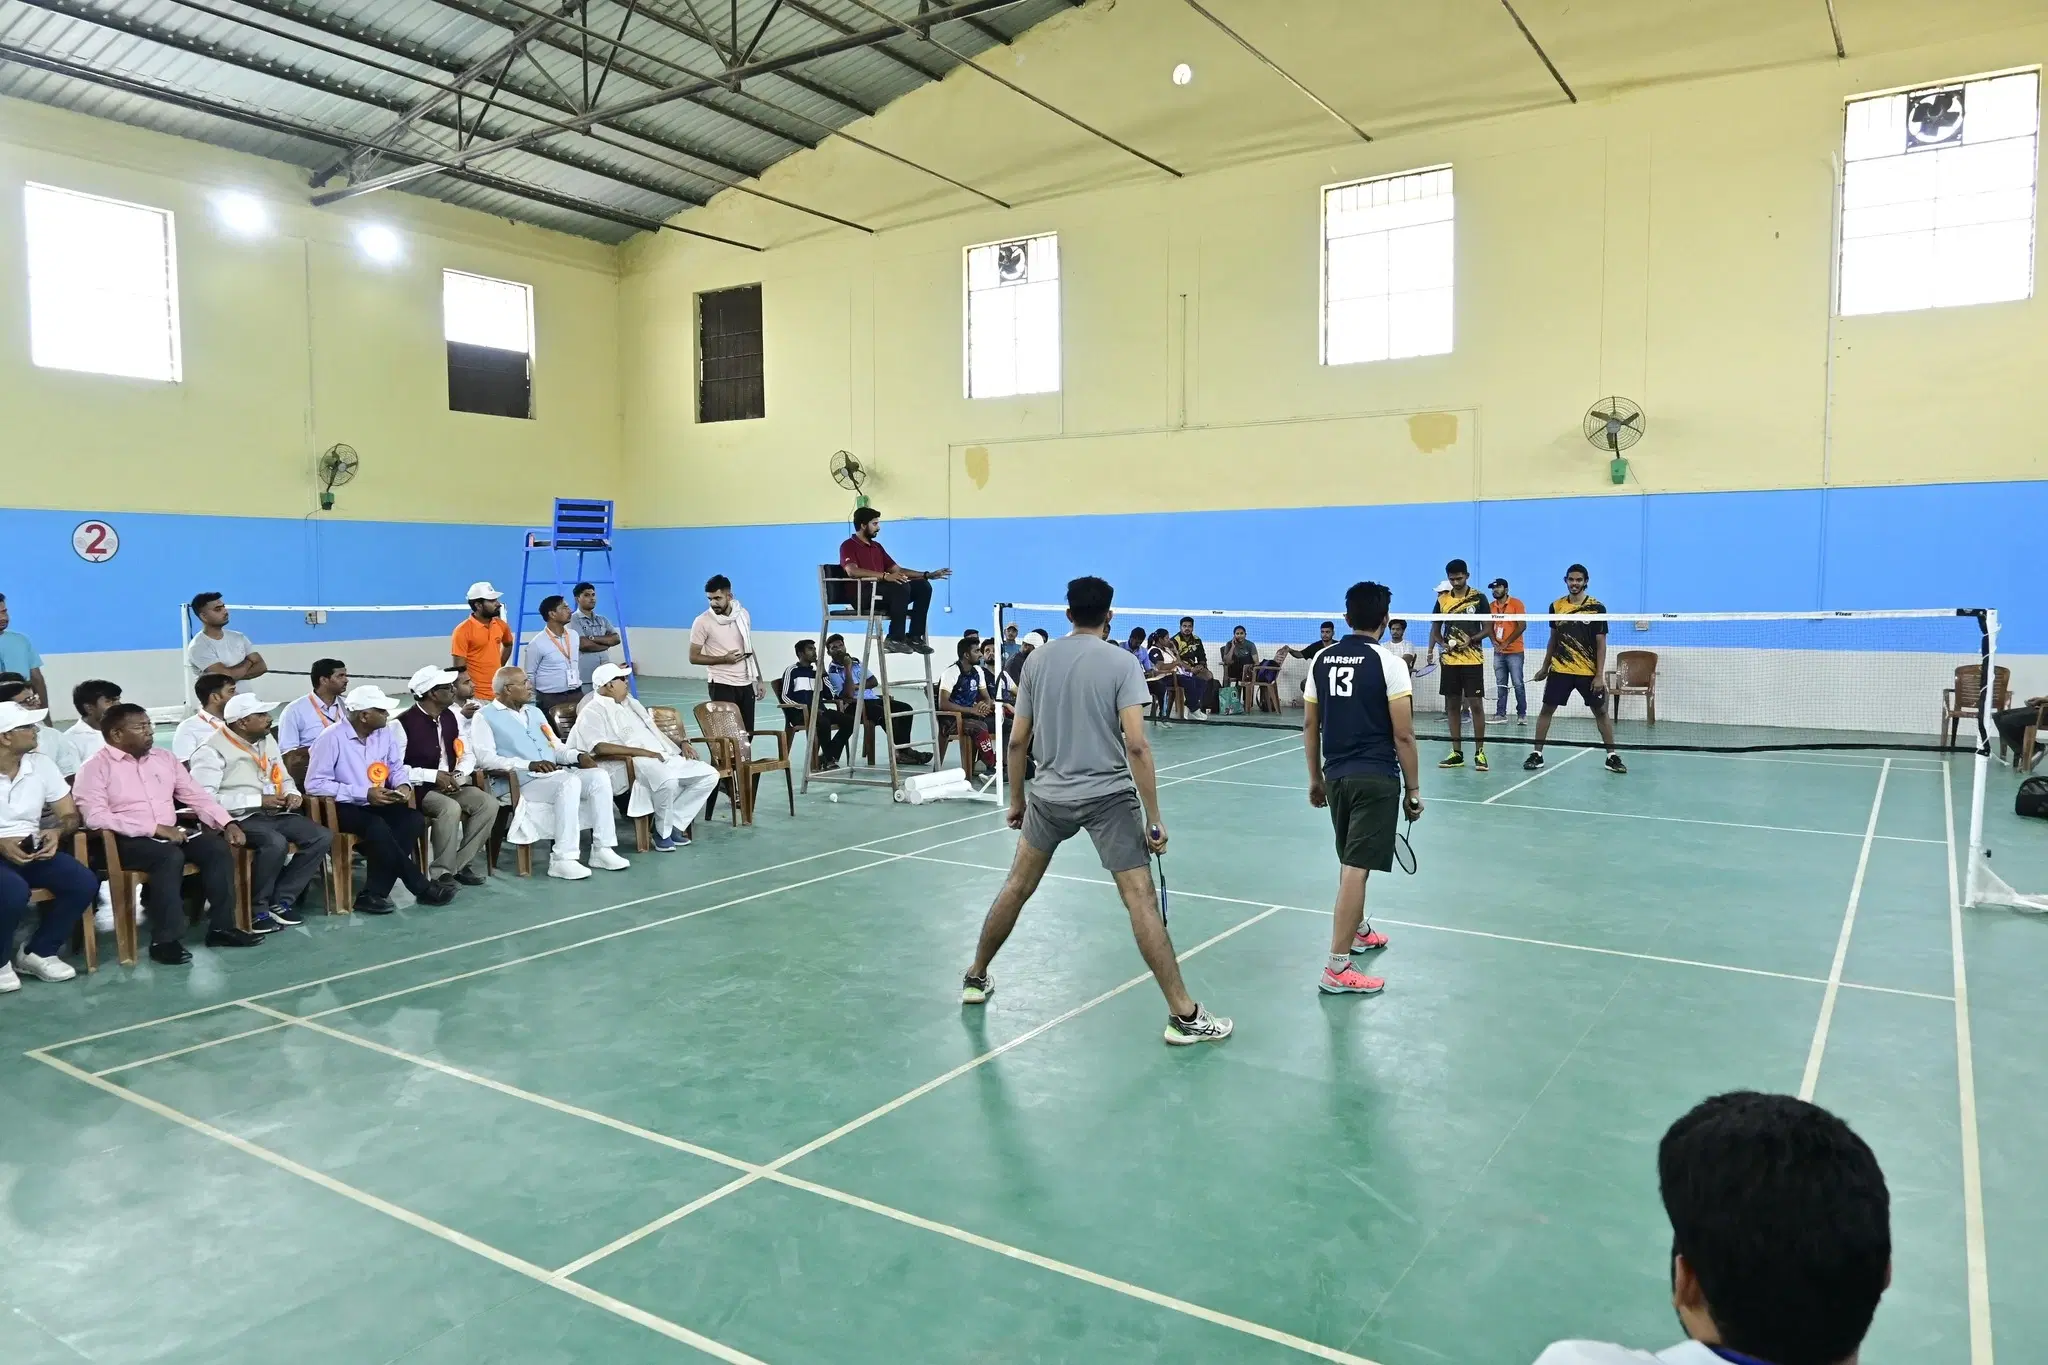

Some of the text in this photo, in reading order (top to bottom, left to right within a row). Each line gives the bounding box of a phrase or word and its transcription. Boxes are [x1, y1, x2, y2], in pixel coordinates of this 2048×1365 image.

[85, 524, 107, 554] 2
[1323, 655, 1365, 664] HARSHIT
[1328, 666, 1355, 697] 13
